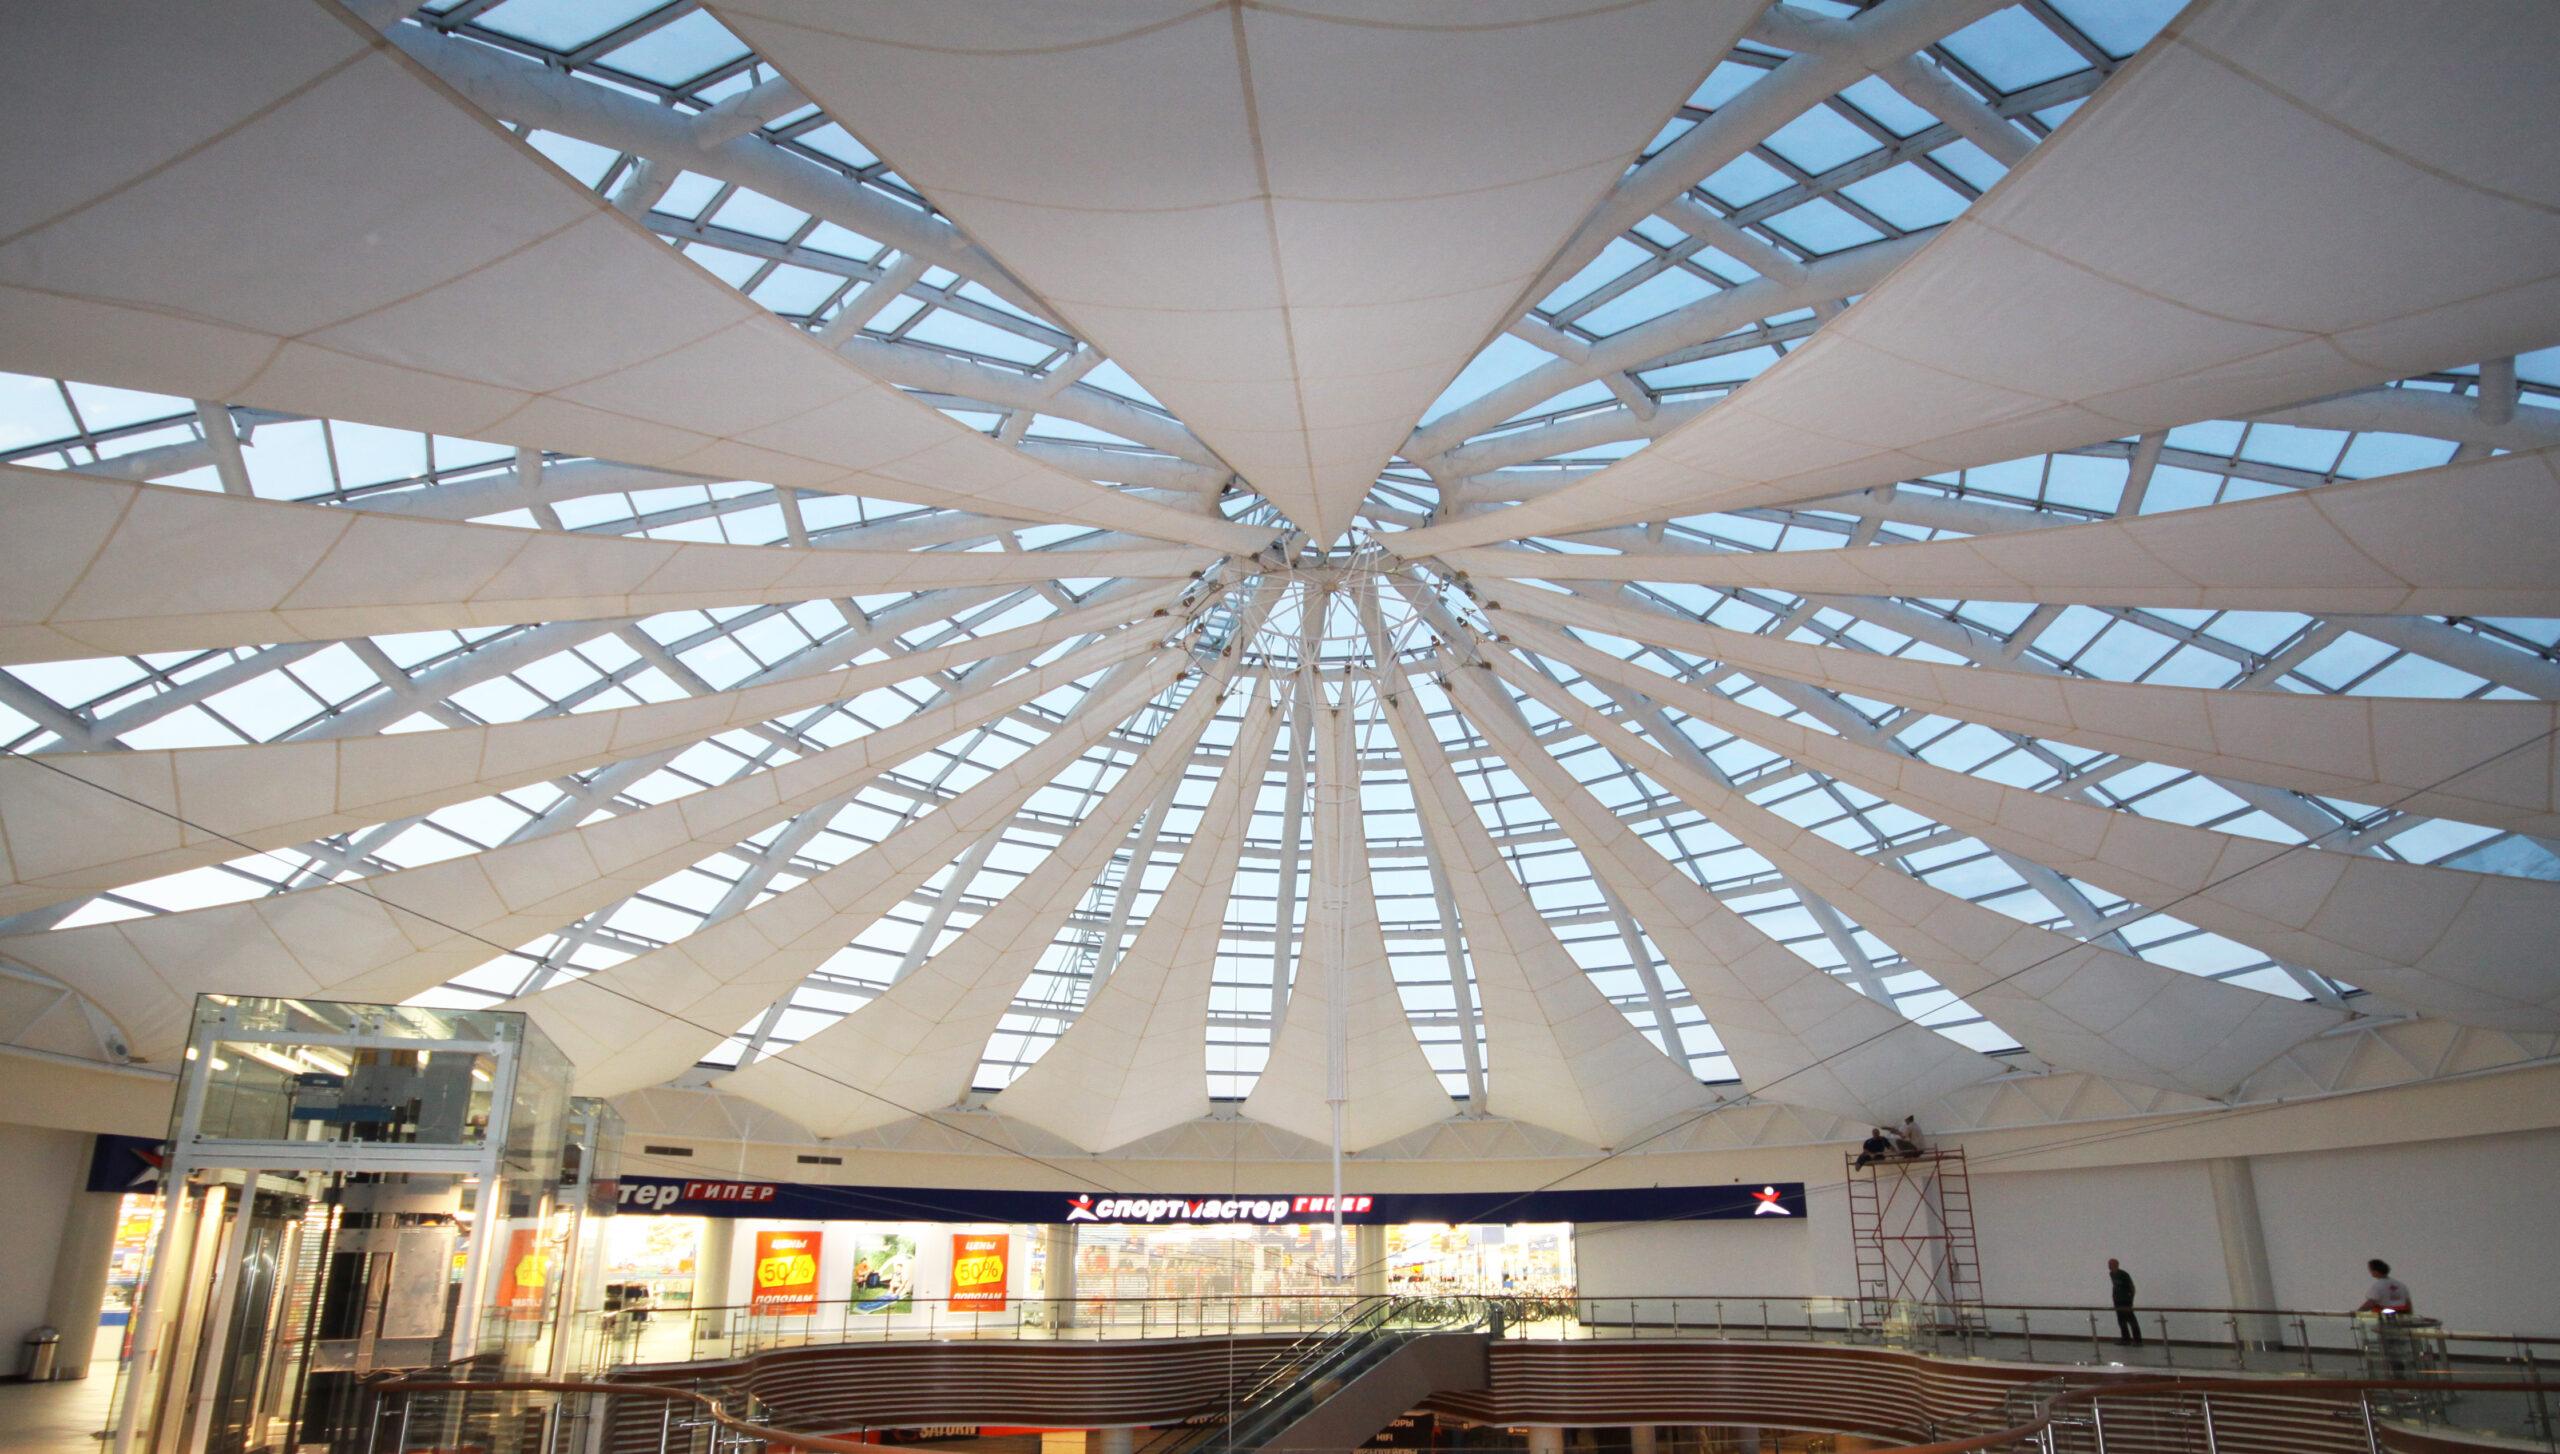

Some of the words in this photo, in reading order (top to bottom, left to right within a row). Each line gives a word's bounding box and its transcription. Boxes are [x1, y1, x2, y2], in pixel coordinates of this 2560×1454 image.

[688, 1184, 774, 1200] ГИПЕР
[1294, 1197, 1372, 1212] ГИПЕР
[764, 1260, 810, 1282] 50%
[960, 1260, 998, 1280] 50%
[755, 1294, 813, 1304] ПОПОЛАМ
[953, 1292, 1002, 1300] ПОПОЛАМ
